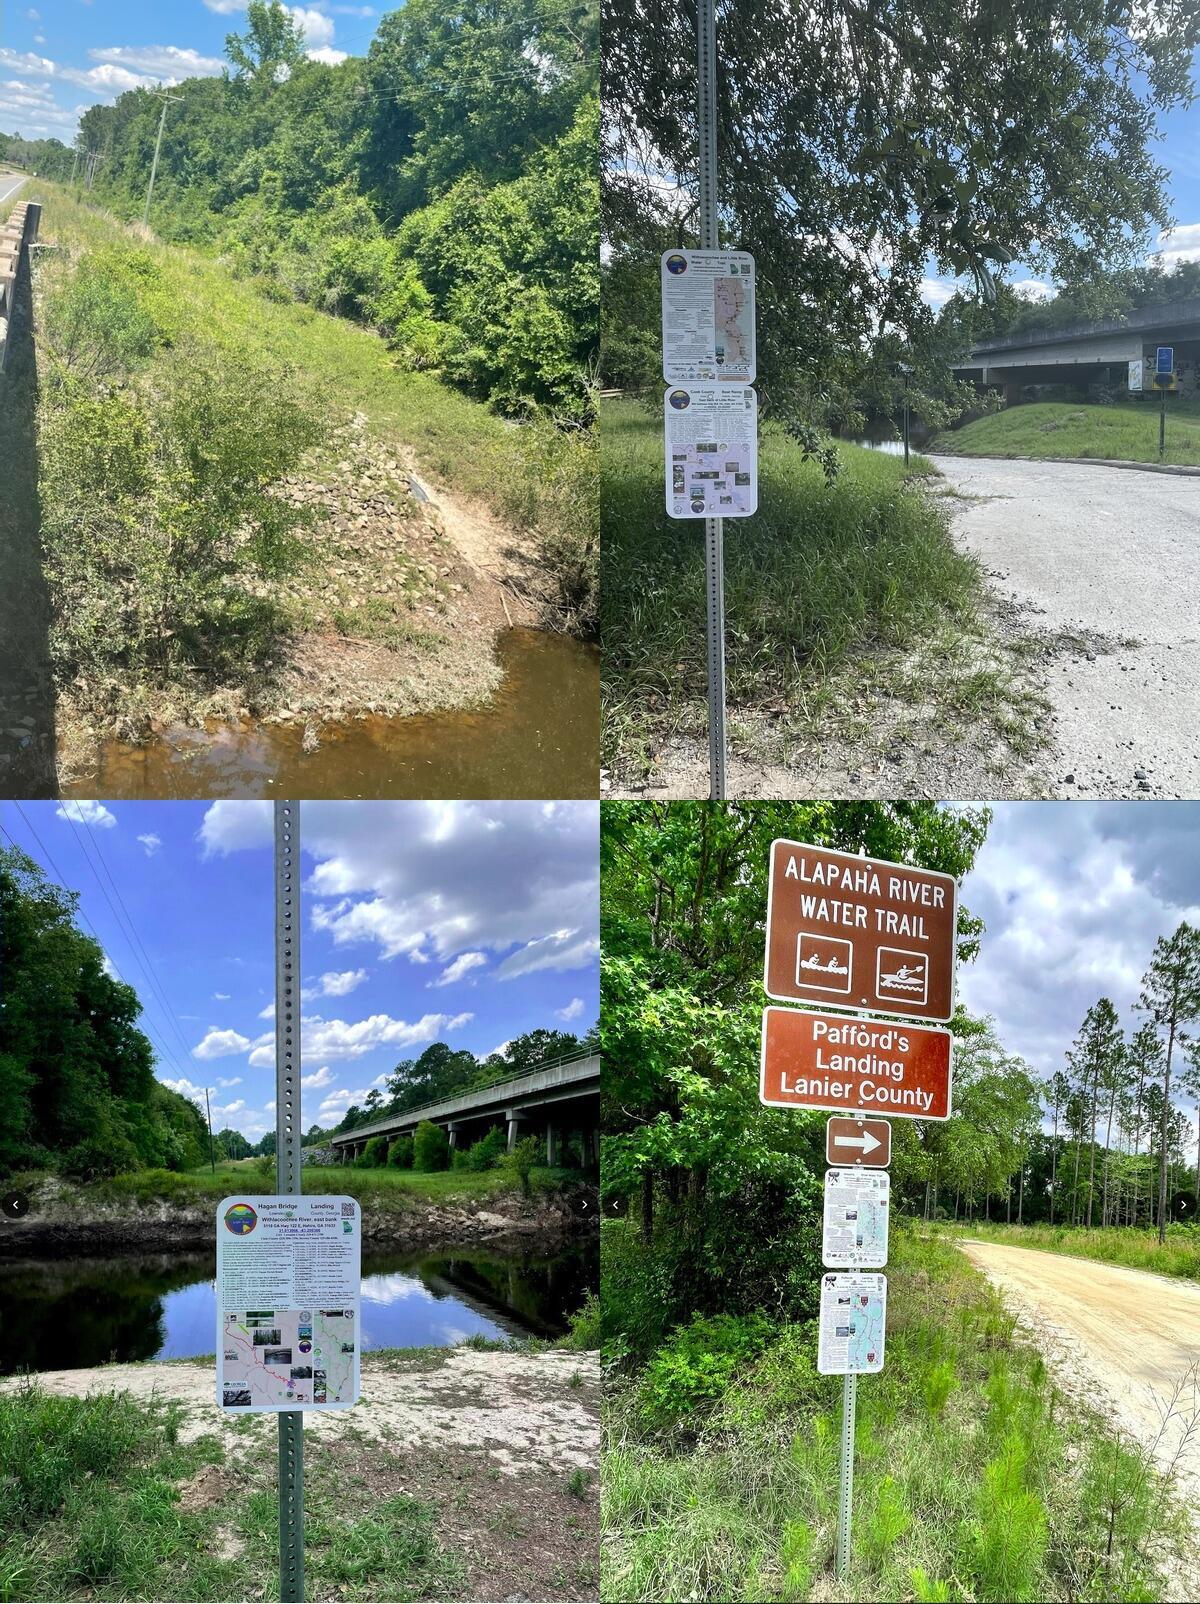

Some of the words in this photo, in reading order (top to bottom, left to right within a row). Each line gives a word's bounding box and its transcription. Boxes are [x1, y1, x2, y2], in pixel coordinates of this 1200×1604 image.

[784, 855, 881, 896] ALAPAHA
[889, 877, 945, 908] RIVER
[800, 894, 868, 928] WATER
[875, 908, 929, 940] TRAIL
[813, 1020, 909, 1052] Pafford's
[816, 1048, 904, 1081] Landing
[780, 1072, 852, 1099] Lanier
[859, 1080, 934, 1111] County
